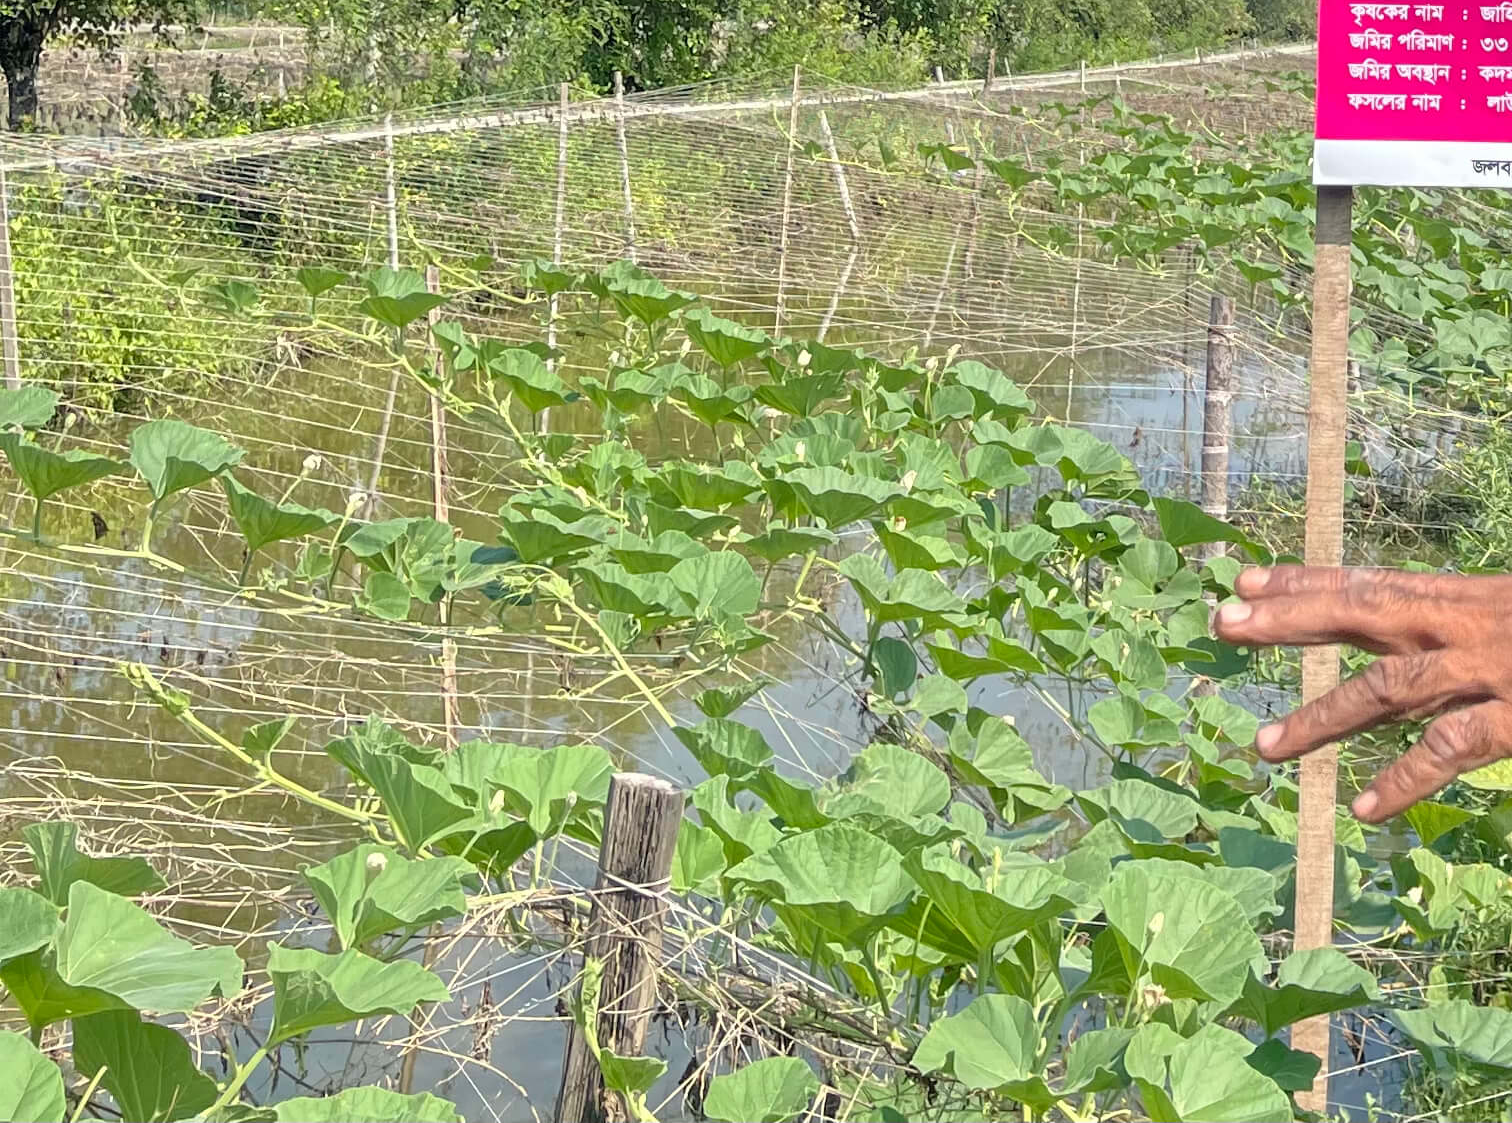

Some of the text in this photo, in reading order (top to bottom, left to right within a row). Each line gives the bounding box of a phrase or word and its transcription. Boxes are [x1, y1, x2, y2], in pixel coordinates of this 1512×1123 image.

[1350, 3, 1410, 26] কৃষকের
[1415, 4, 1444, 22] নাম
[1348, 28, 1393, 50] জমির
[1398, 29, 1454, 52] পরিমাণ
[1480, 39, 1508, 52] ৩৩
[1347, 58, 1392, 80] জমির
[1396, 65, 1451, 85] অবস্থান
[1347, 93, 1407, 111] ফসলের
[1412, 94, 1441, 111] নাম
